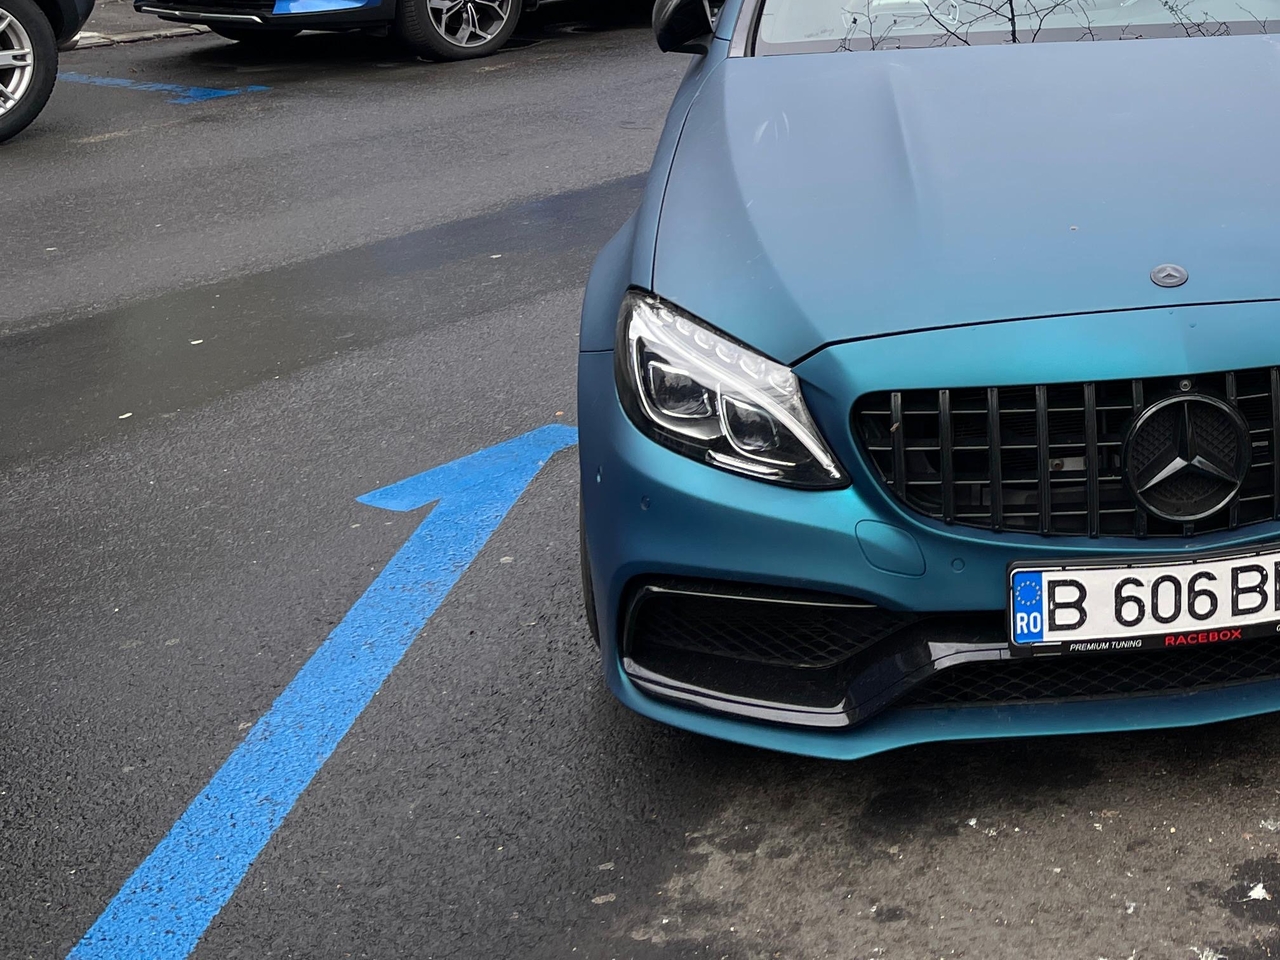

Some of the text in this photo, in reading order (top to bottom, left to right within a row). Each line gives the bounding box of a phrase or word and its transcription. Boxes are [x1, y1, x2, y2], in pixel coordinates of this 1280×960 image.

[1047, 578, 1088, 632] B
[1016, 611, 1041, 635] RO
[1069, 639, 1143, 652] PREMIUM TUNING
[1164, 628, 1243, 647] RACEBOX
